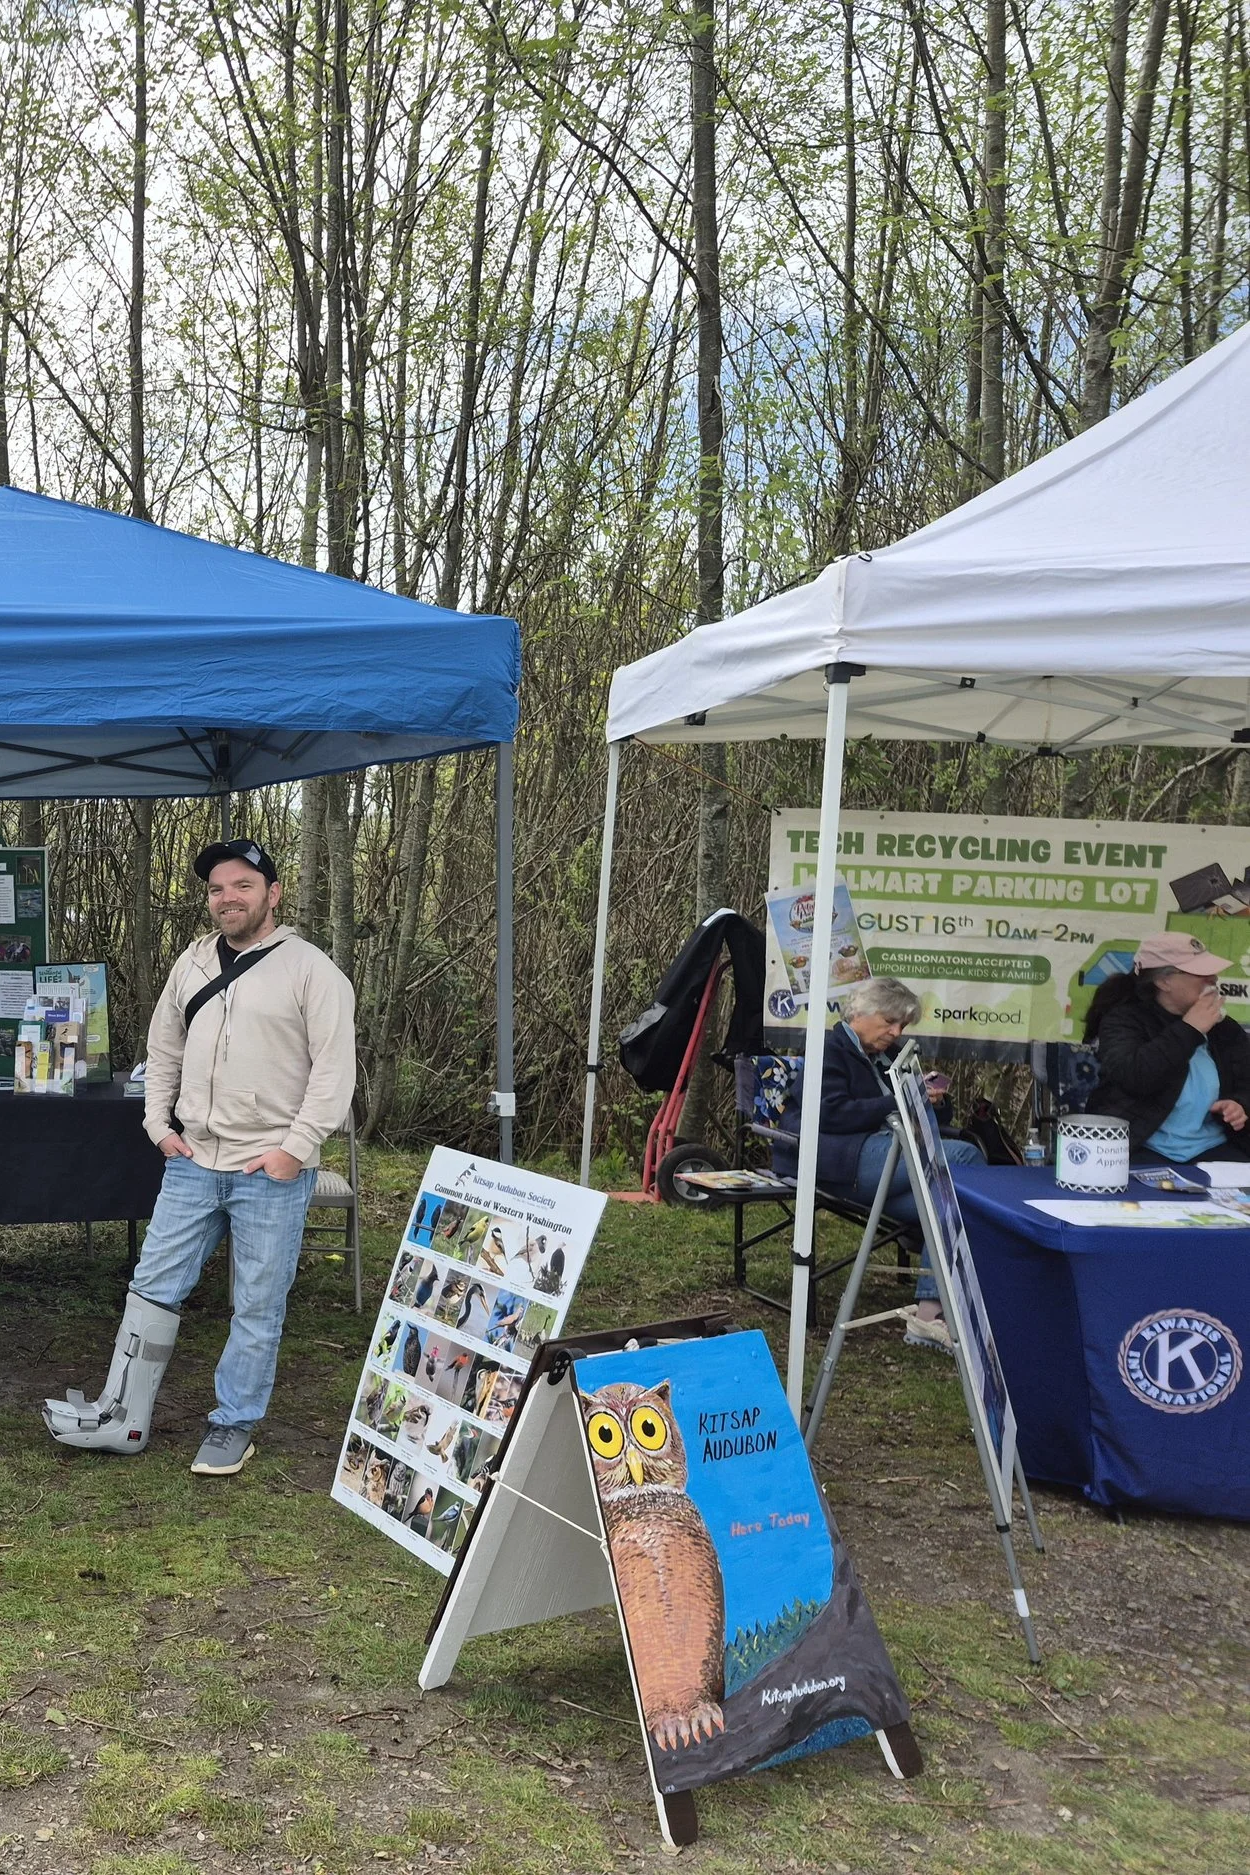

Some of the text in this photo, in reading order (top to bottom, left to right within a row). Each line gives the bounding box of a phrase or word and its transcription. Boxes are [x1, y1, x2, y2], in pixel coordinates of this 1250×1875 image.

[876, 833, 1051, 864] RECYCLING
[1063, 840, 1168, 869] EVENT
[952, 873, 1084, 902] PARKING
[1095, 881, 1150, 905] LOT
[856, 913, 924, 934] GUST
[934, 914, 974, 935] 16th
[870, 963, 1046, 982] UPPORTING LOCAL KIDS & FAMILIES
[881, 952, 1032, 969] CASH DONATONS ACCEPTED
[934, 1007, 1022, 1026] sparkgood
[472, 1174, 495, 1189] Kitsap
[495, 1181, 527, 1199] Audubon
[527, 1191, 557, 1210] Society
[434, 1183, 463, 1199] Common
[463, 1192, 482, 1206] Birds
[482, 1199, 492, 1208] of
[492, 1201, 524, 1219] Western
[526, 1211, 573, 1235] Washington
[1140, 1317, 1222, 1342] KIWANIS
[1156, 1331, 1208, 1391] K
[1128, 1350, 1231, 1405] INTERNATIONAL
[698, 1406, 761, 1436] KITSAP
[702, 1429, 778, 1464] AUDUBON
[731, 1511, 810, 1537] Here Today
[761, 1675, 846, 1707] KitsapAudubon.org
